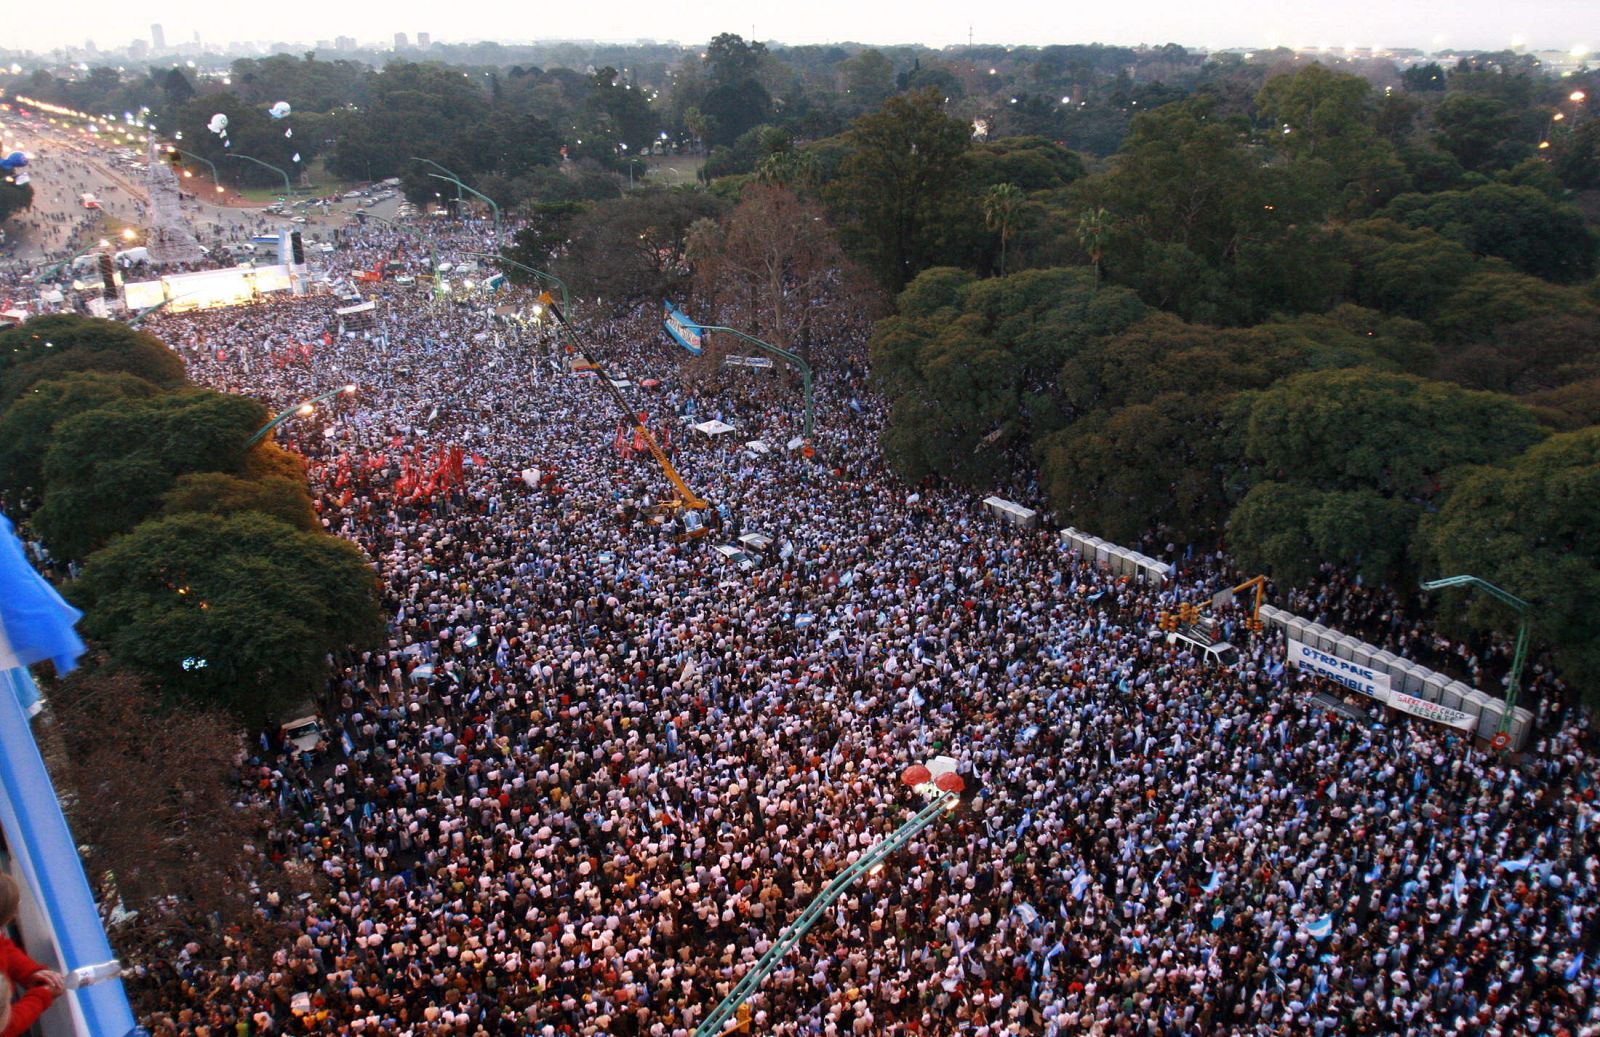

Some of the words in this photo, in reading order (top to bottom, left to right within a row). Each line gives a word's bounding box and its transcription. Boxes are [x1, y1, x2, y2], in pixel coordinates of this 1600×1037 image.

[1302, 647, 1338, 667] OTRO
[1341, 662, 1373, 681] PAIS
[1318, 668, 1375, 696] POSIBLE
